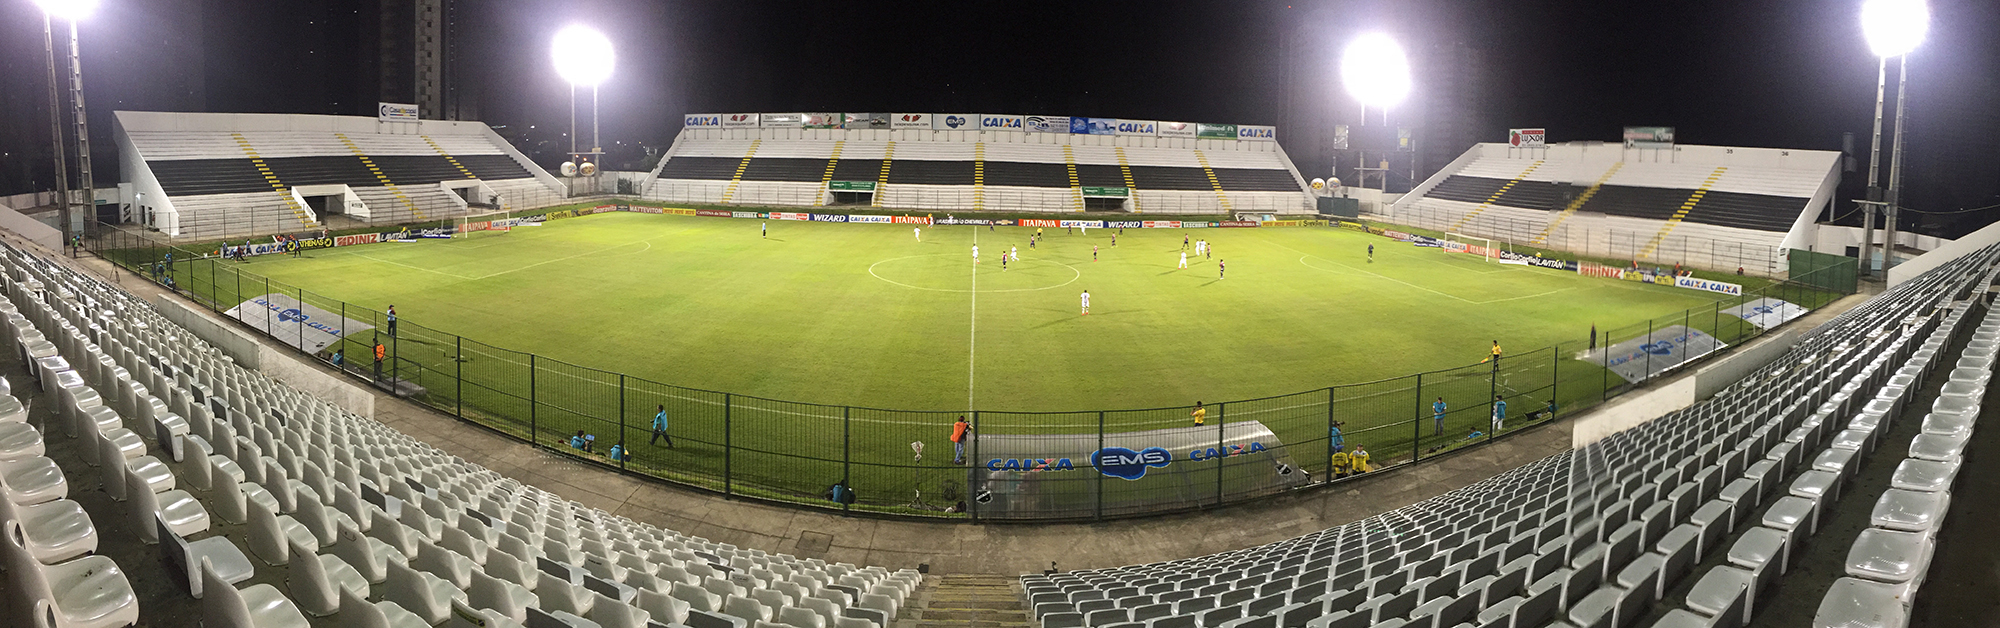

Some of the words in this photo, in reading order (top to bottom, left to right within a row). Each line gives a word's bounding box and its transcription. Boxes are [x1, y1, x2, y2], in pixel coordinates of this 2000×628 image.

[686, 116, 718, 126] CAIXA
[983, 117, 1021, 128] CAIXA
[1118, 123, 1154, 134] CAIXA
[1240, 128, 1273, 138] CAIXA
[1521, 134, 1544, 144] LUXOR
[813, 214, 846, 222] WIZARD
[895, 216, 928, 225] ITAIPAVA
[1023, 219, 1056, 227] ITAIPAVA
[1108, 221, 1140, 229] WIZARD
[349, 233, 377, 245] DINIZ
[1679, 278, 1707, 290] CAIXA
[1709, 284, 1738, 295] CAIXA
[987, 457, 1075, 472] CAIXA
[1101, 451, 1164, 467] EMS
[1189, 441, 1267, 462] CAIXA
